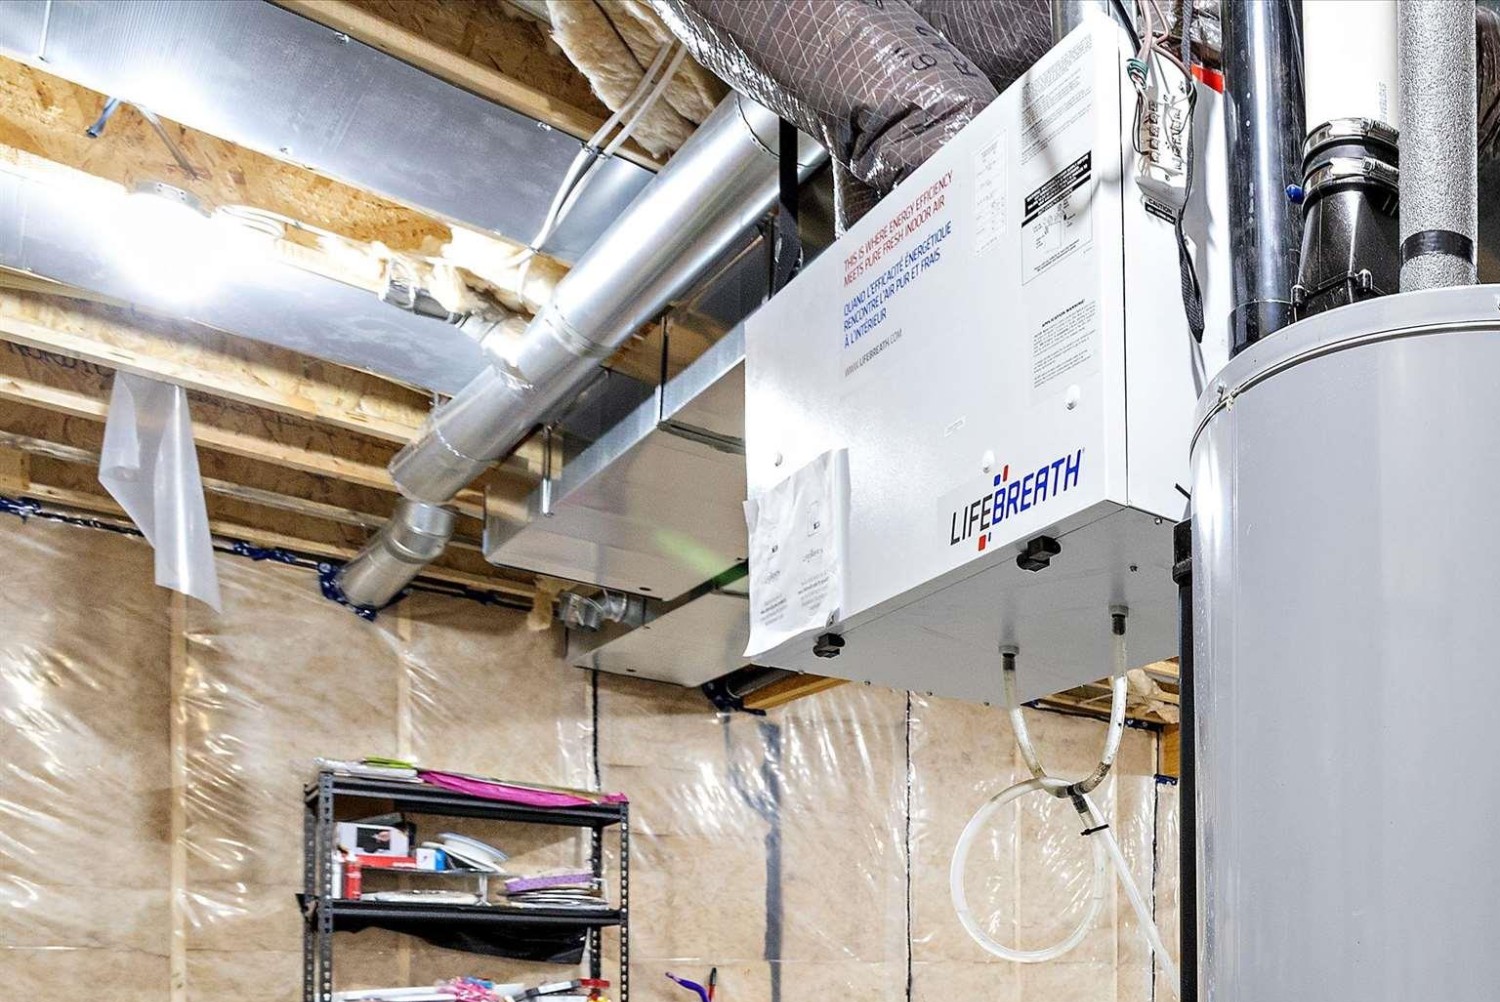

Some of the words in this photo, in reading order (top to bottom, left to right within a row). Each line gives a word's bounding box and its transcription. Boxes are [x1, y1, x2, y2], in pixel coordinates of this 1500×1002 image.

[844, 254, 857, 271] THIS
[865, 229, 888, 256] WHERE
[889, 203, 914, 234] ENERGY
[915, 170, 953, 212] EFFICIENCY
[844, 266, 864, 288] MEETS
[865, 250, 882, 273] PURE
[883, 235, 903, 261] FRESH
[905, 211, 932, 242] INDOOR
[933, 195, 945, 215] AIR
[844, 301, 879, 332] RENCONTRE
[879, 288, 894, 311] L'AIR
[896, 276, 909, 299] PUR
[921, 249, 941, 278] FRAIS
[844, 290, 865, 317] QUAND
[845, 328, 902, 378] WWW.LIFEBREATH.COM
[950, 448, 1081, 546] LIFEBREATH
